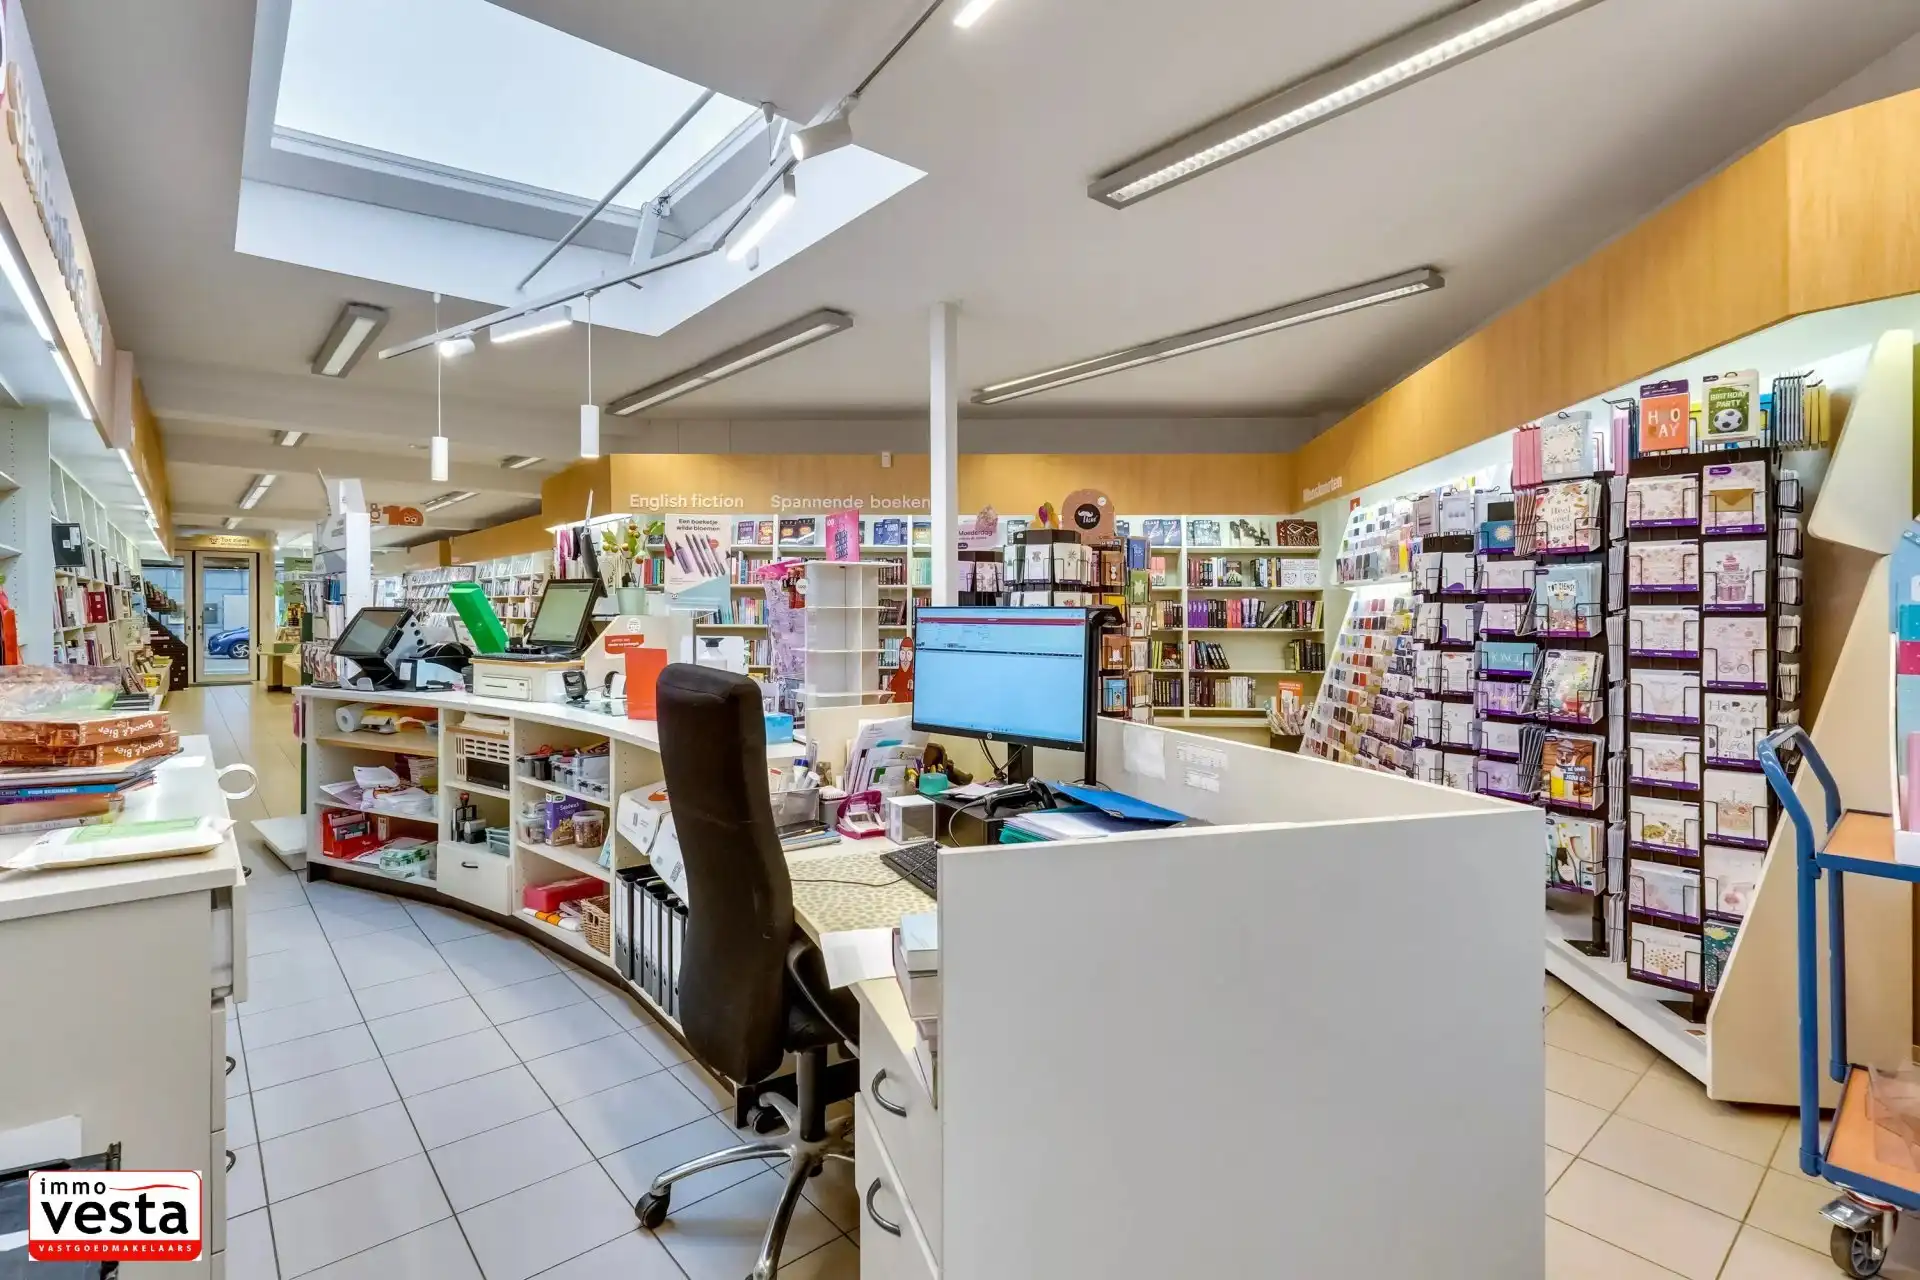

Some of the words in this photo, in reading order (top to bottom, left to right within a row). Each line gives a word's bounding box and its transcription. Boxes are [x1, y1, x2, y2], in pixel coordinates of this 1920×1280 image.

[1710, 391, 1747, 401] BIRTHDAY
[1716, 399, 1741, 408] PARTY
[630, 494, 687, 511] English
[691, 494, 744, 508] fiction
[771, 495, 864, 511] Spannende
[871, 495, 931, 508] boeken
[691, 518, 718, 526] boeketje
[98, 726, 119, 739] Bier
[113, 746, 133, 758] Bier
